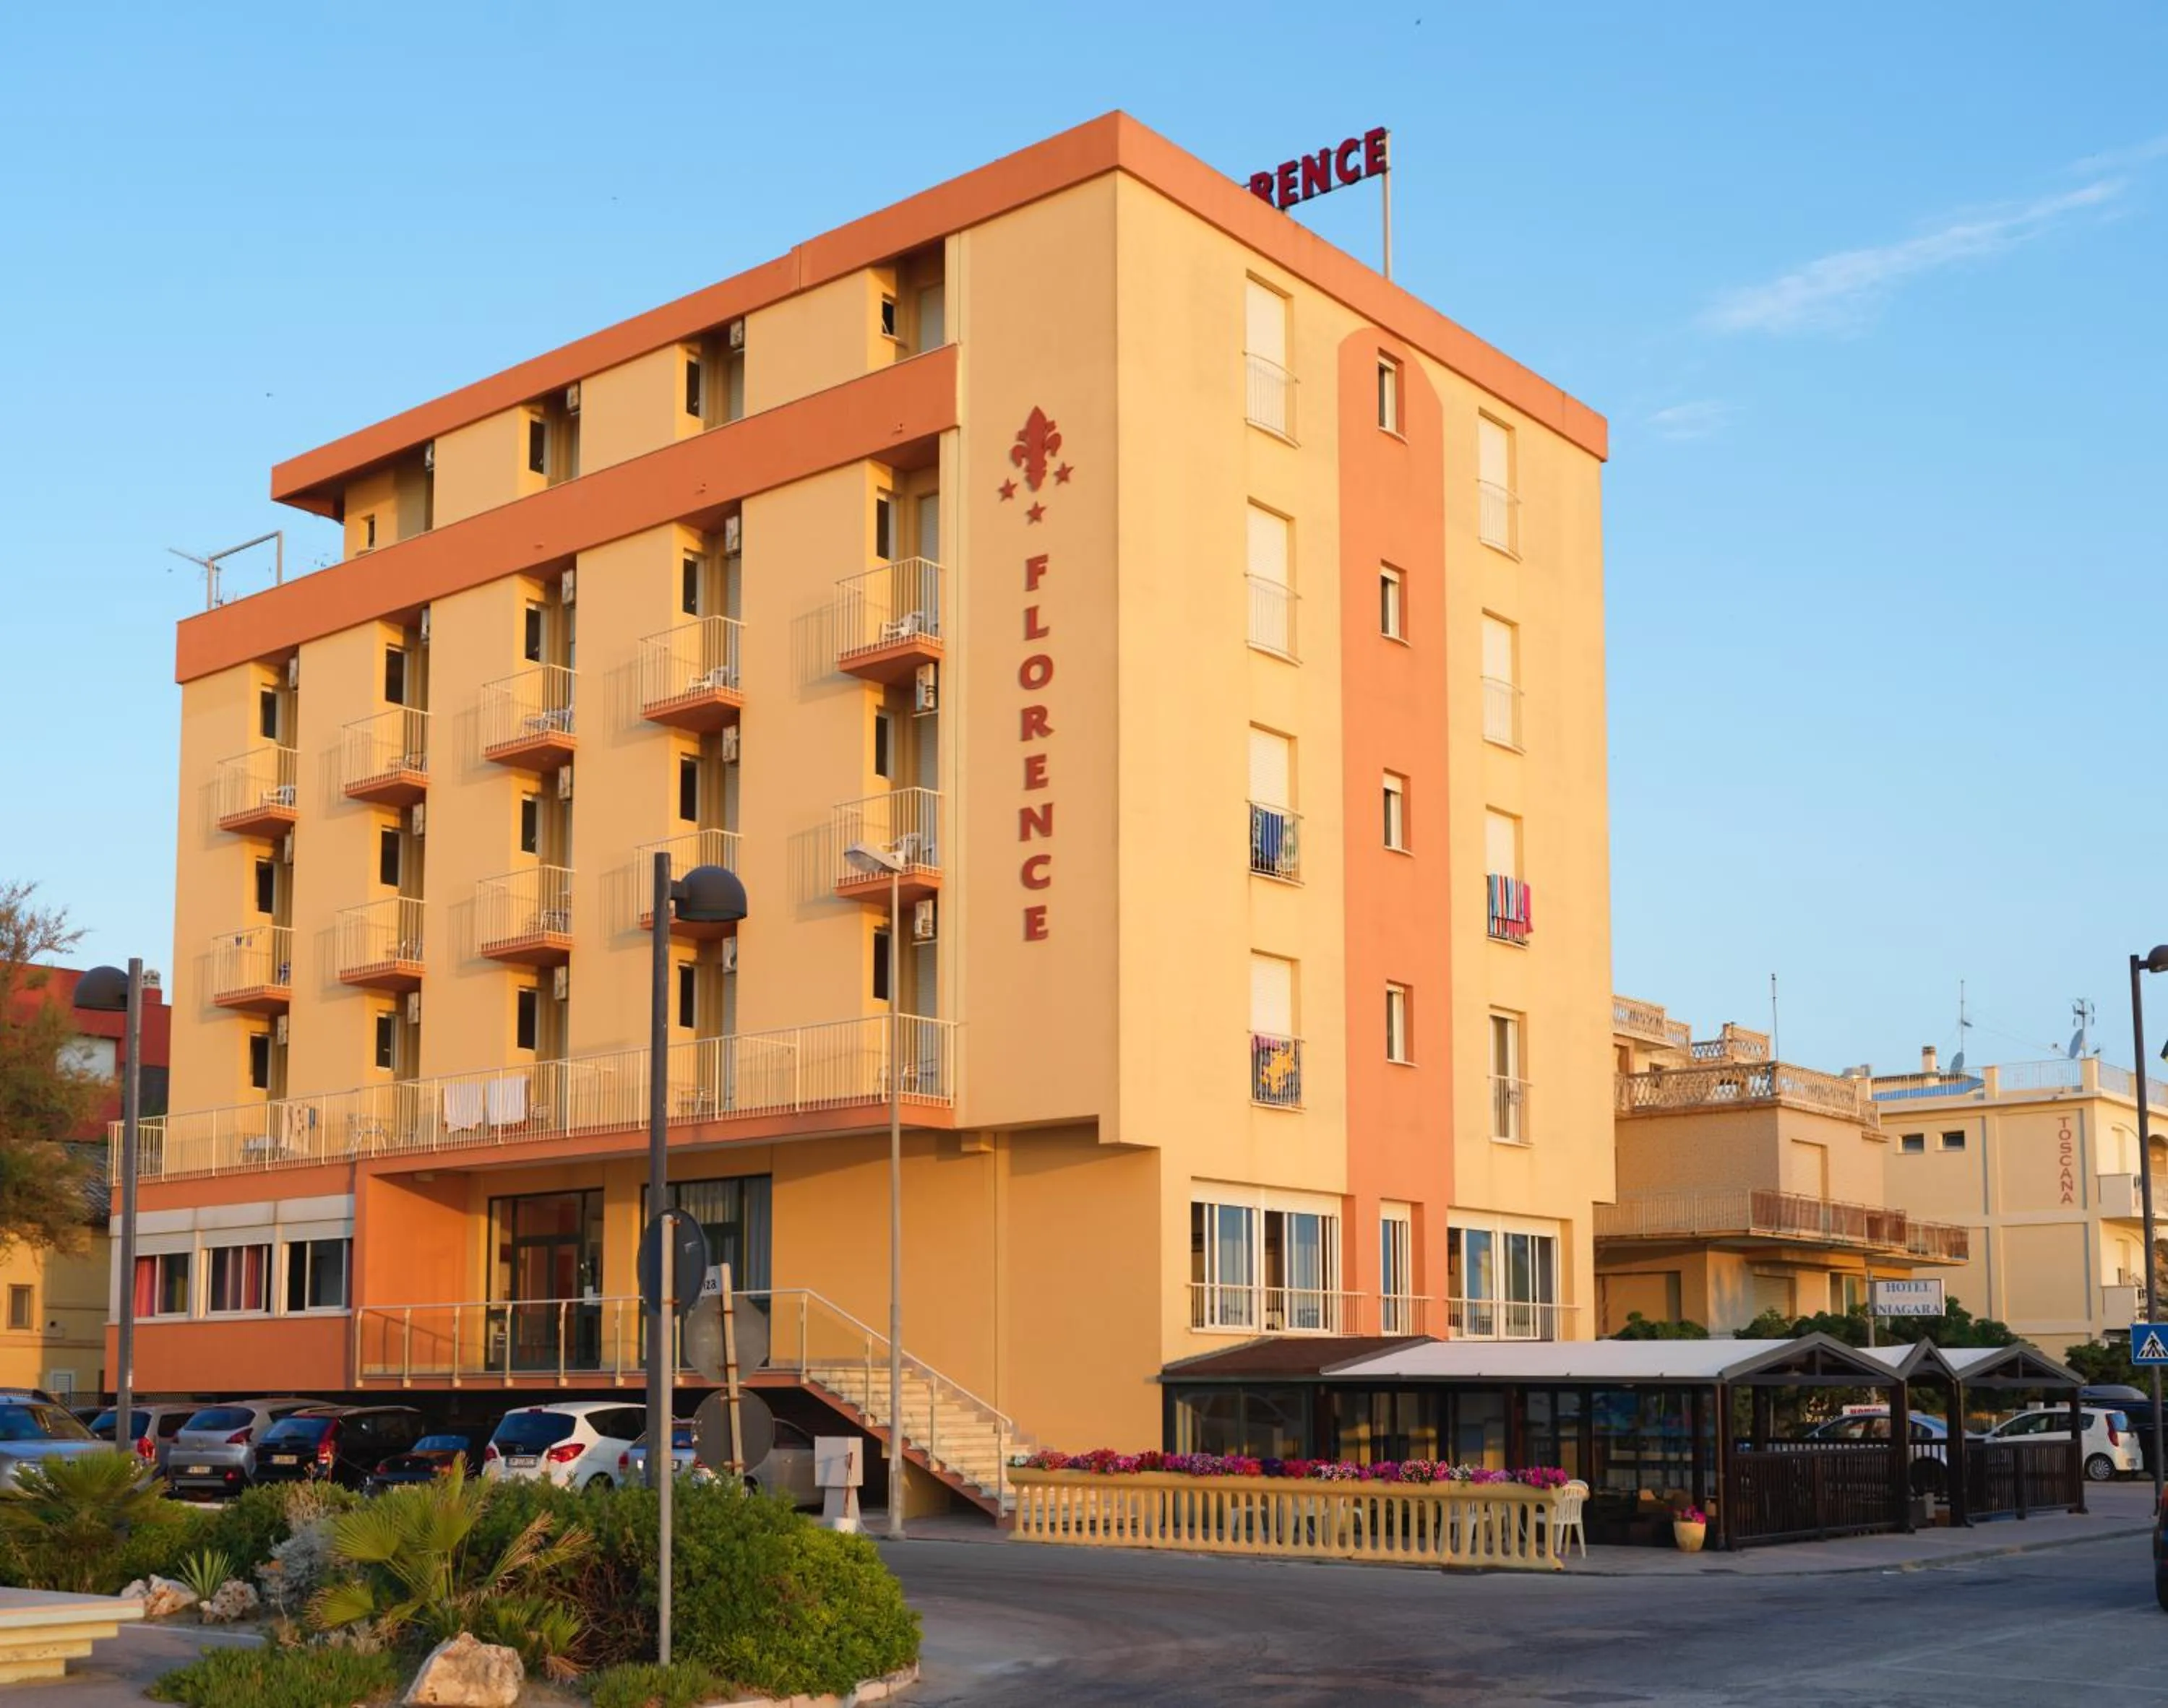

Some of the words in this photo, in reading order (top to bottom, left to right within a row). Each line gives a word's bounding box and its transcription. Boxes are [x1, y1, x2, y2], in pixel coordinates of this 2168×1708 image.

[1018, 554, 1055, 942] FLORENCE
[2057, 1116, 2074, 1204] TOSCANA
[1877, 1303, 1942, 1314] NIAGARA
[1885, 1282, 1932, 1293] HOTEL
